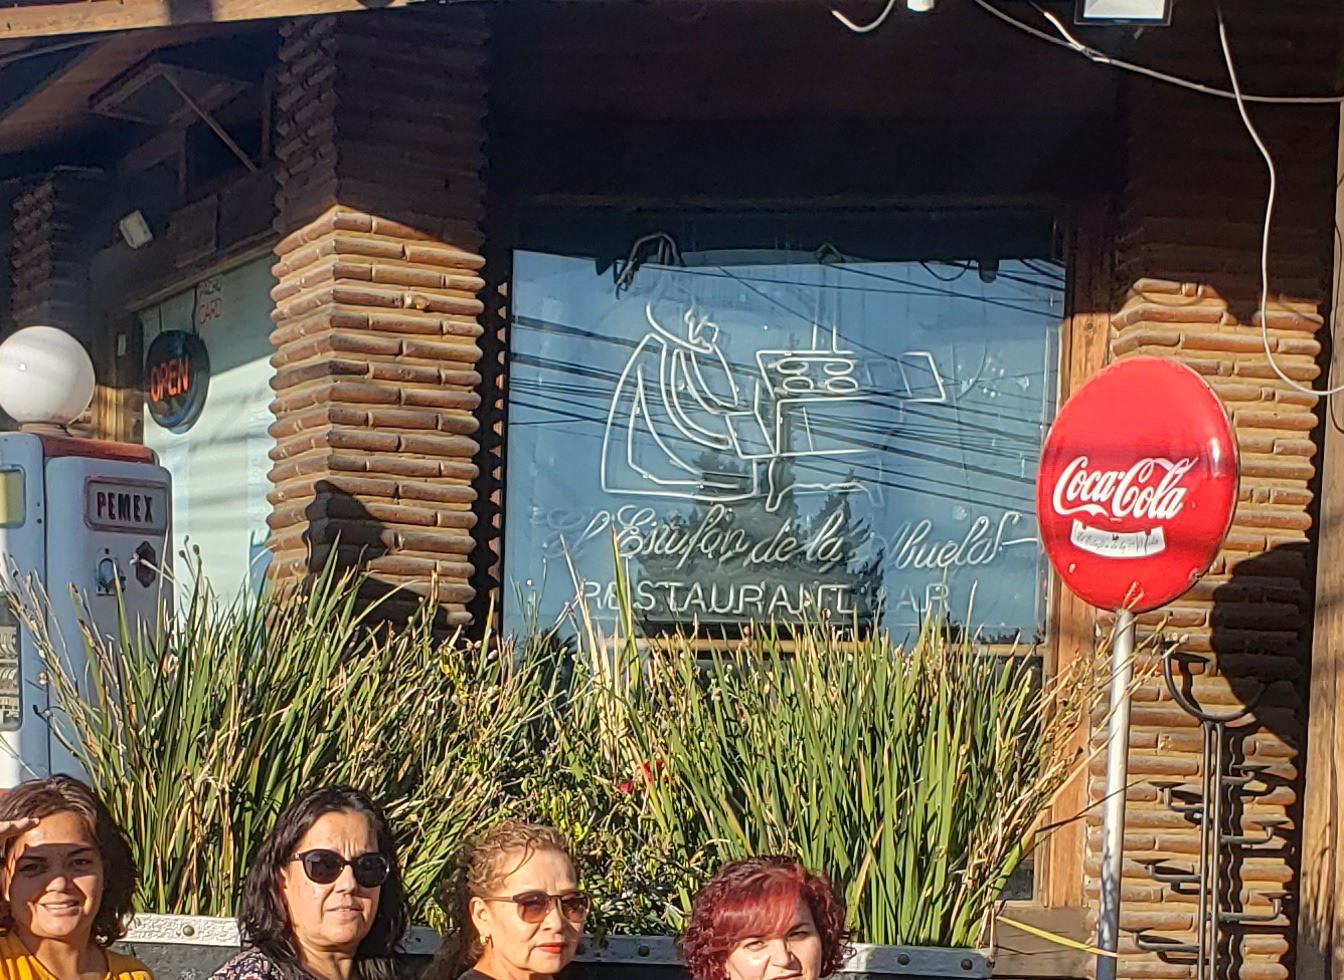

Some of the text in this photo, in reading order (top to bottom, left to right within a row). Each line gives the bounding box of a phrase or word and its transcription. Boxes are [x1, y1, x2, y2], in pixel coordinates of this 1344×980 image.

[150, 354, 189, 402] OPEN
[97, 491, 154, 523] PEMEX
[1053, 456, 1199, 520] Coca-Cola
